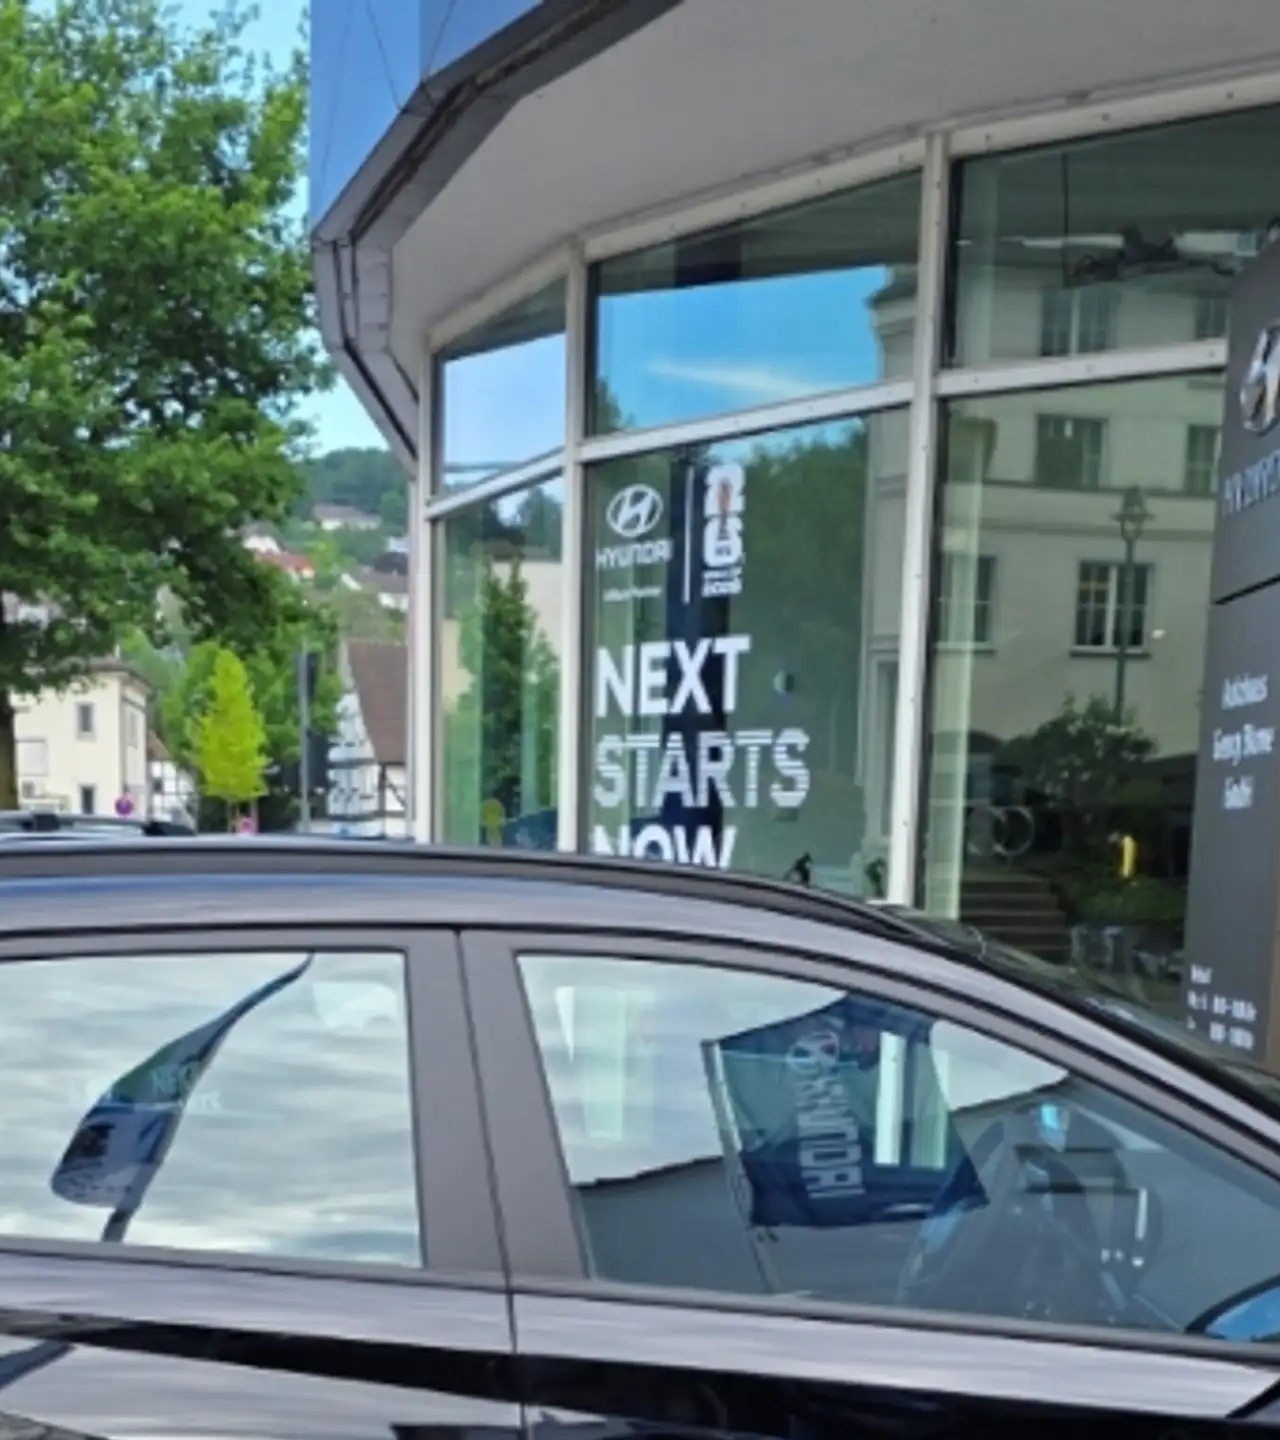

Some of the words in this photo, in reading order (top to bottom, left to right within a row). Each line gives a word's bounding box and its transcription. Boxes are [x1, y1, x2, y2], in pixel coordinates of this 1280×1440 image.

[596, 539, 673, 571] HYUNDAI
[596, 634, 751, 717] NEXT
[593, 728, 810, 808] STARTS
